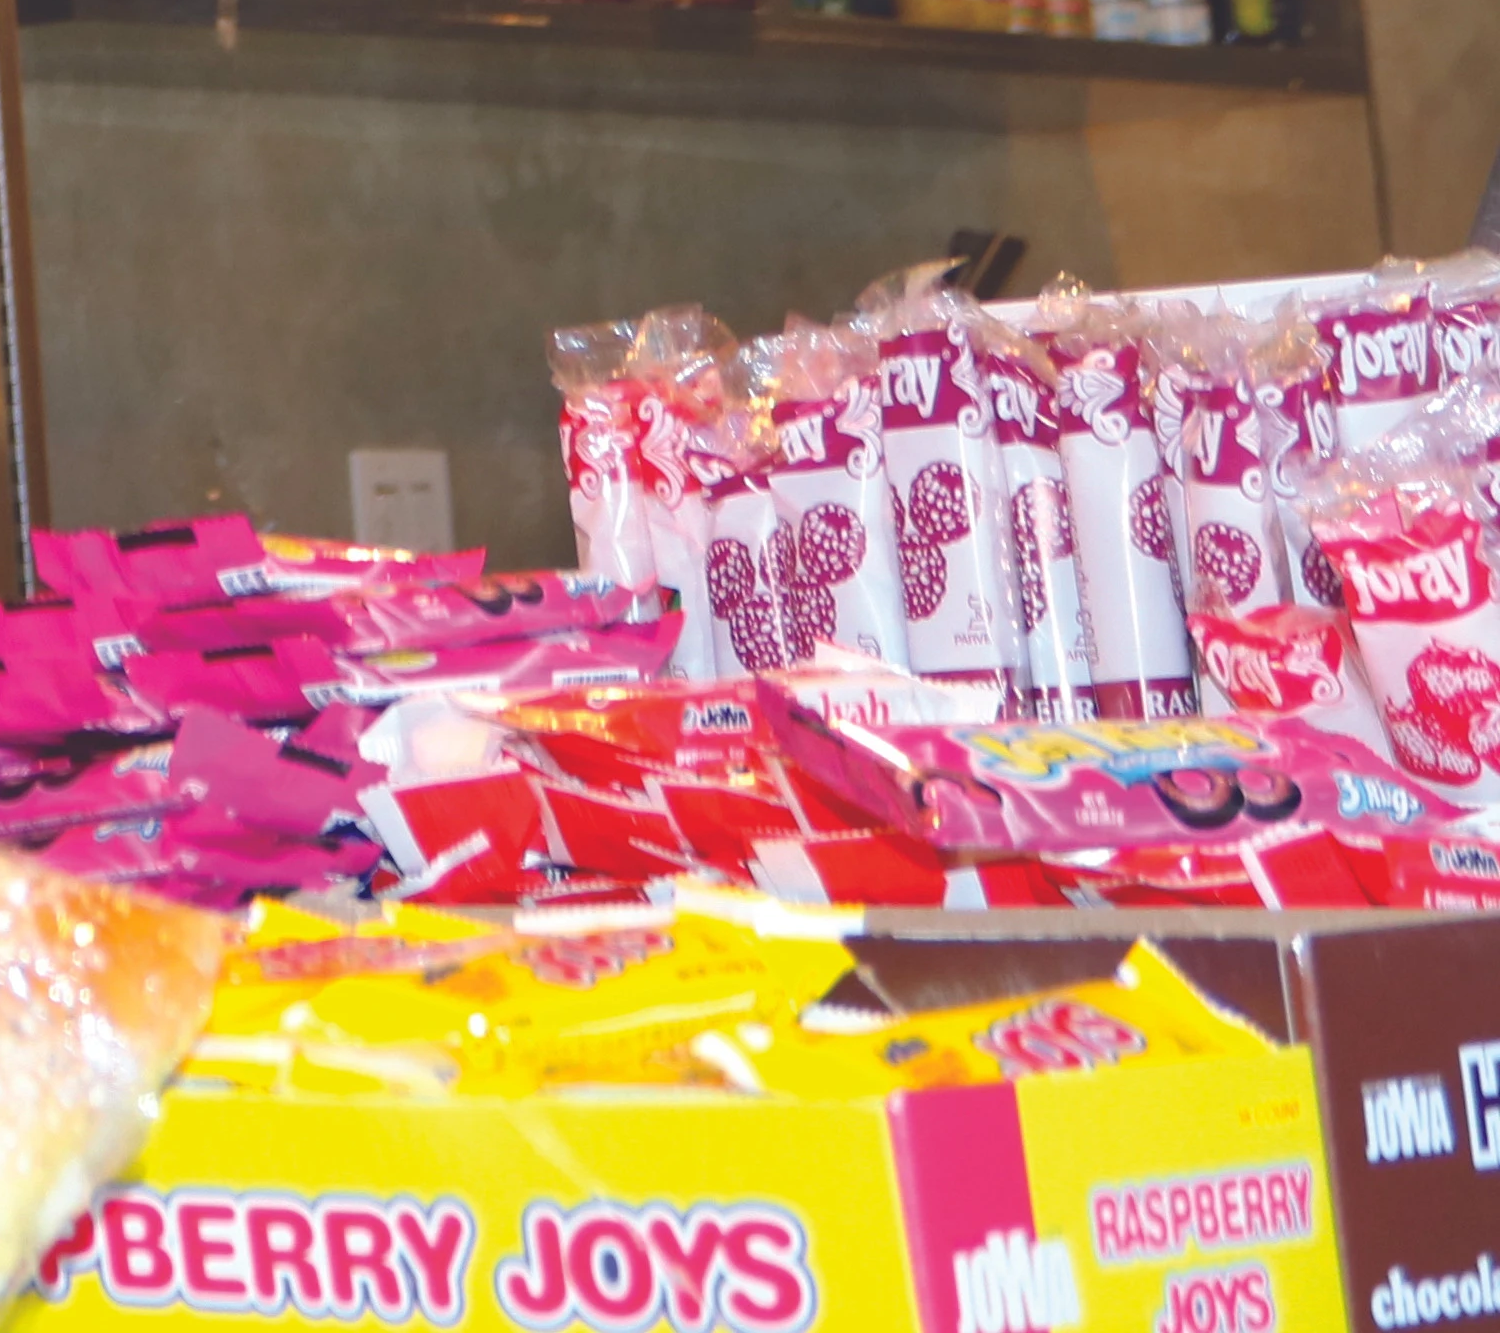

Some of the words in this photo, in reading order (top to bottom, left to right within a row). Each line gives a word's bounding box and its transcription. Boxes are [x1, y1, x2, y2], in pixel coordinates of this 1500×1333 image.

[879, 355, 941, 419] ray
[1333, 319, 1428, 397] joray
[1342, 538, 1472, 616] joray
[1197, 635, 1285, 709] oray
[1094, 1163, 1312, 1261] RASPBERRY
[33, 1191, 472, 1323] BERRY
[499, 1199, 815, 1333] JOYS
[1157, 1264, 1275, 1333] JOYS
